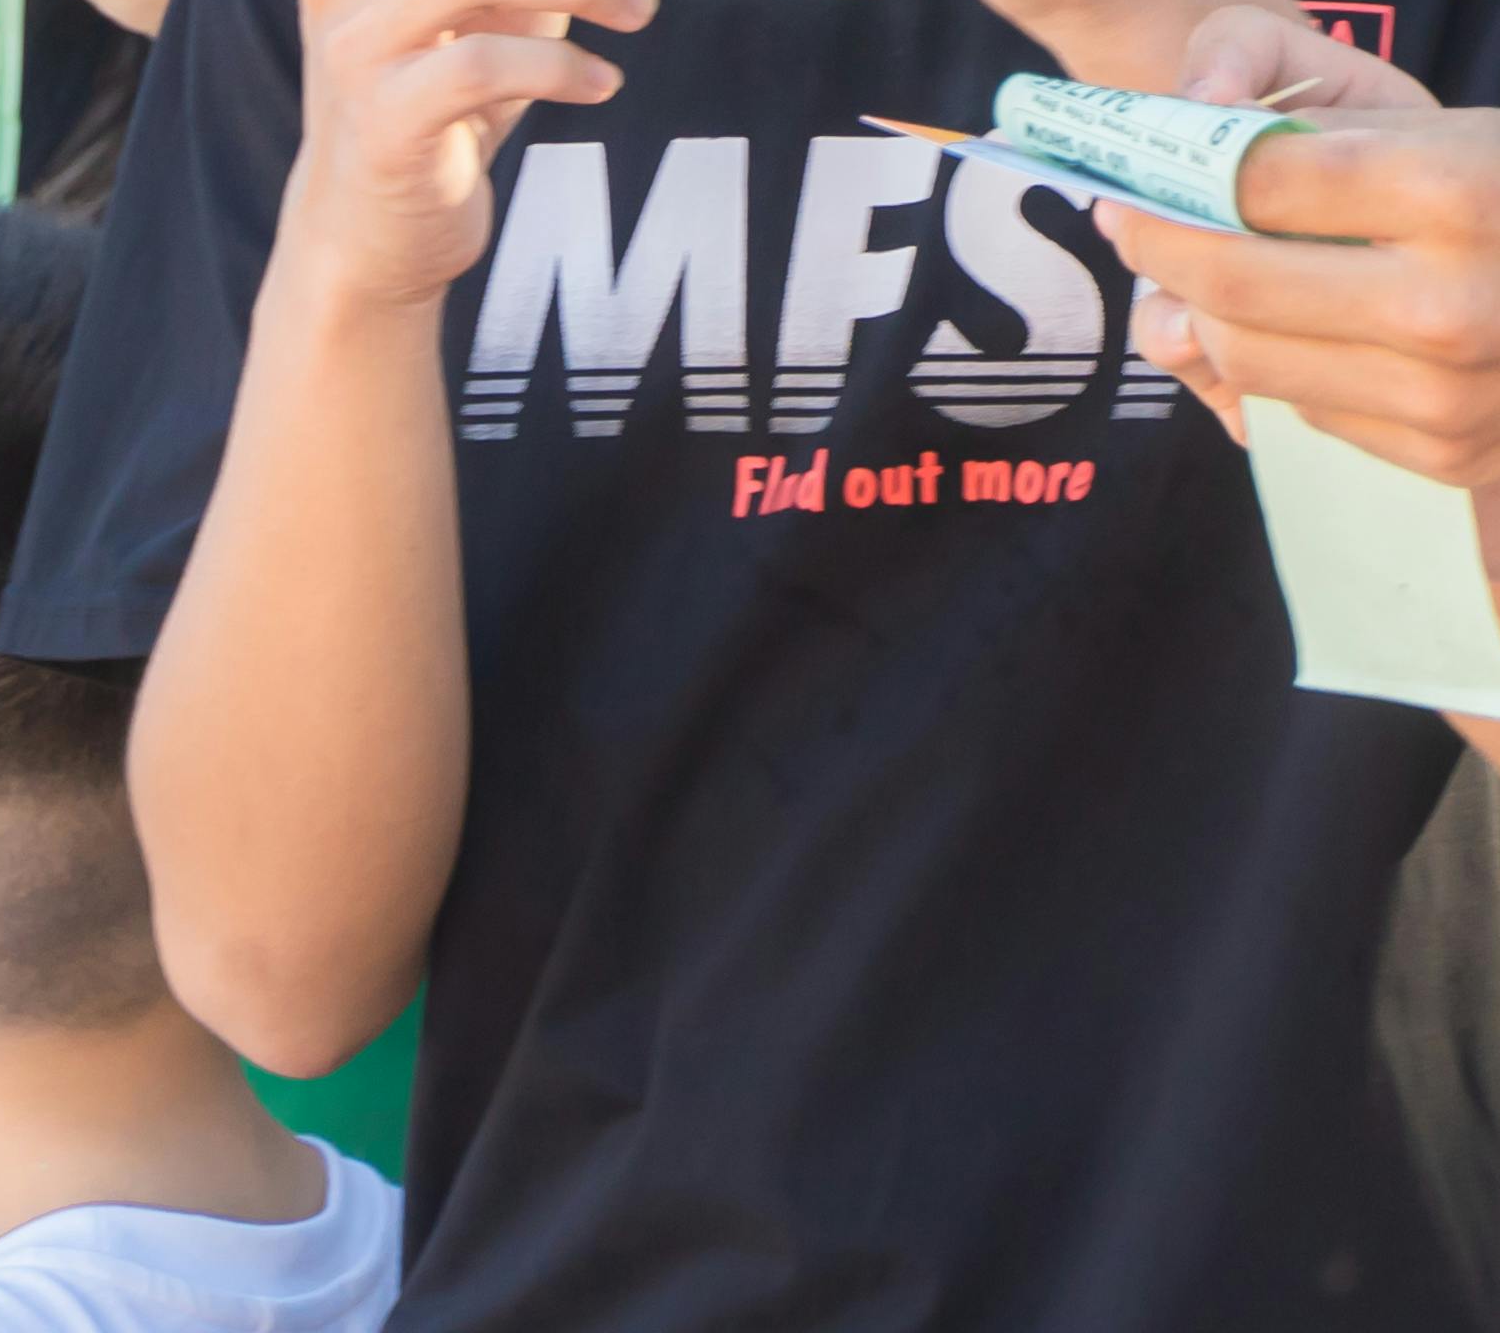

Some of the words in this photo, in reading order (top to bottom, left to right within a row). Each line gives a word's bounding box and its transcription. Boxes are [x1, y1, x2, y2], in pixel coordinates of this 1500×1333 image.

[460, 136, 1182, 440] MFS
[843, 450, 944, 510] out
[961, 455, 1096, 504] more
